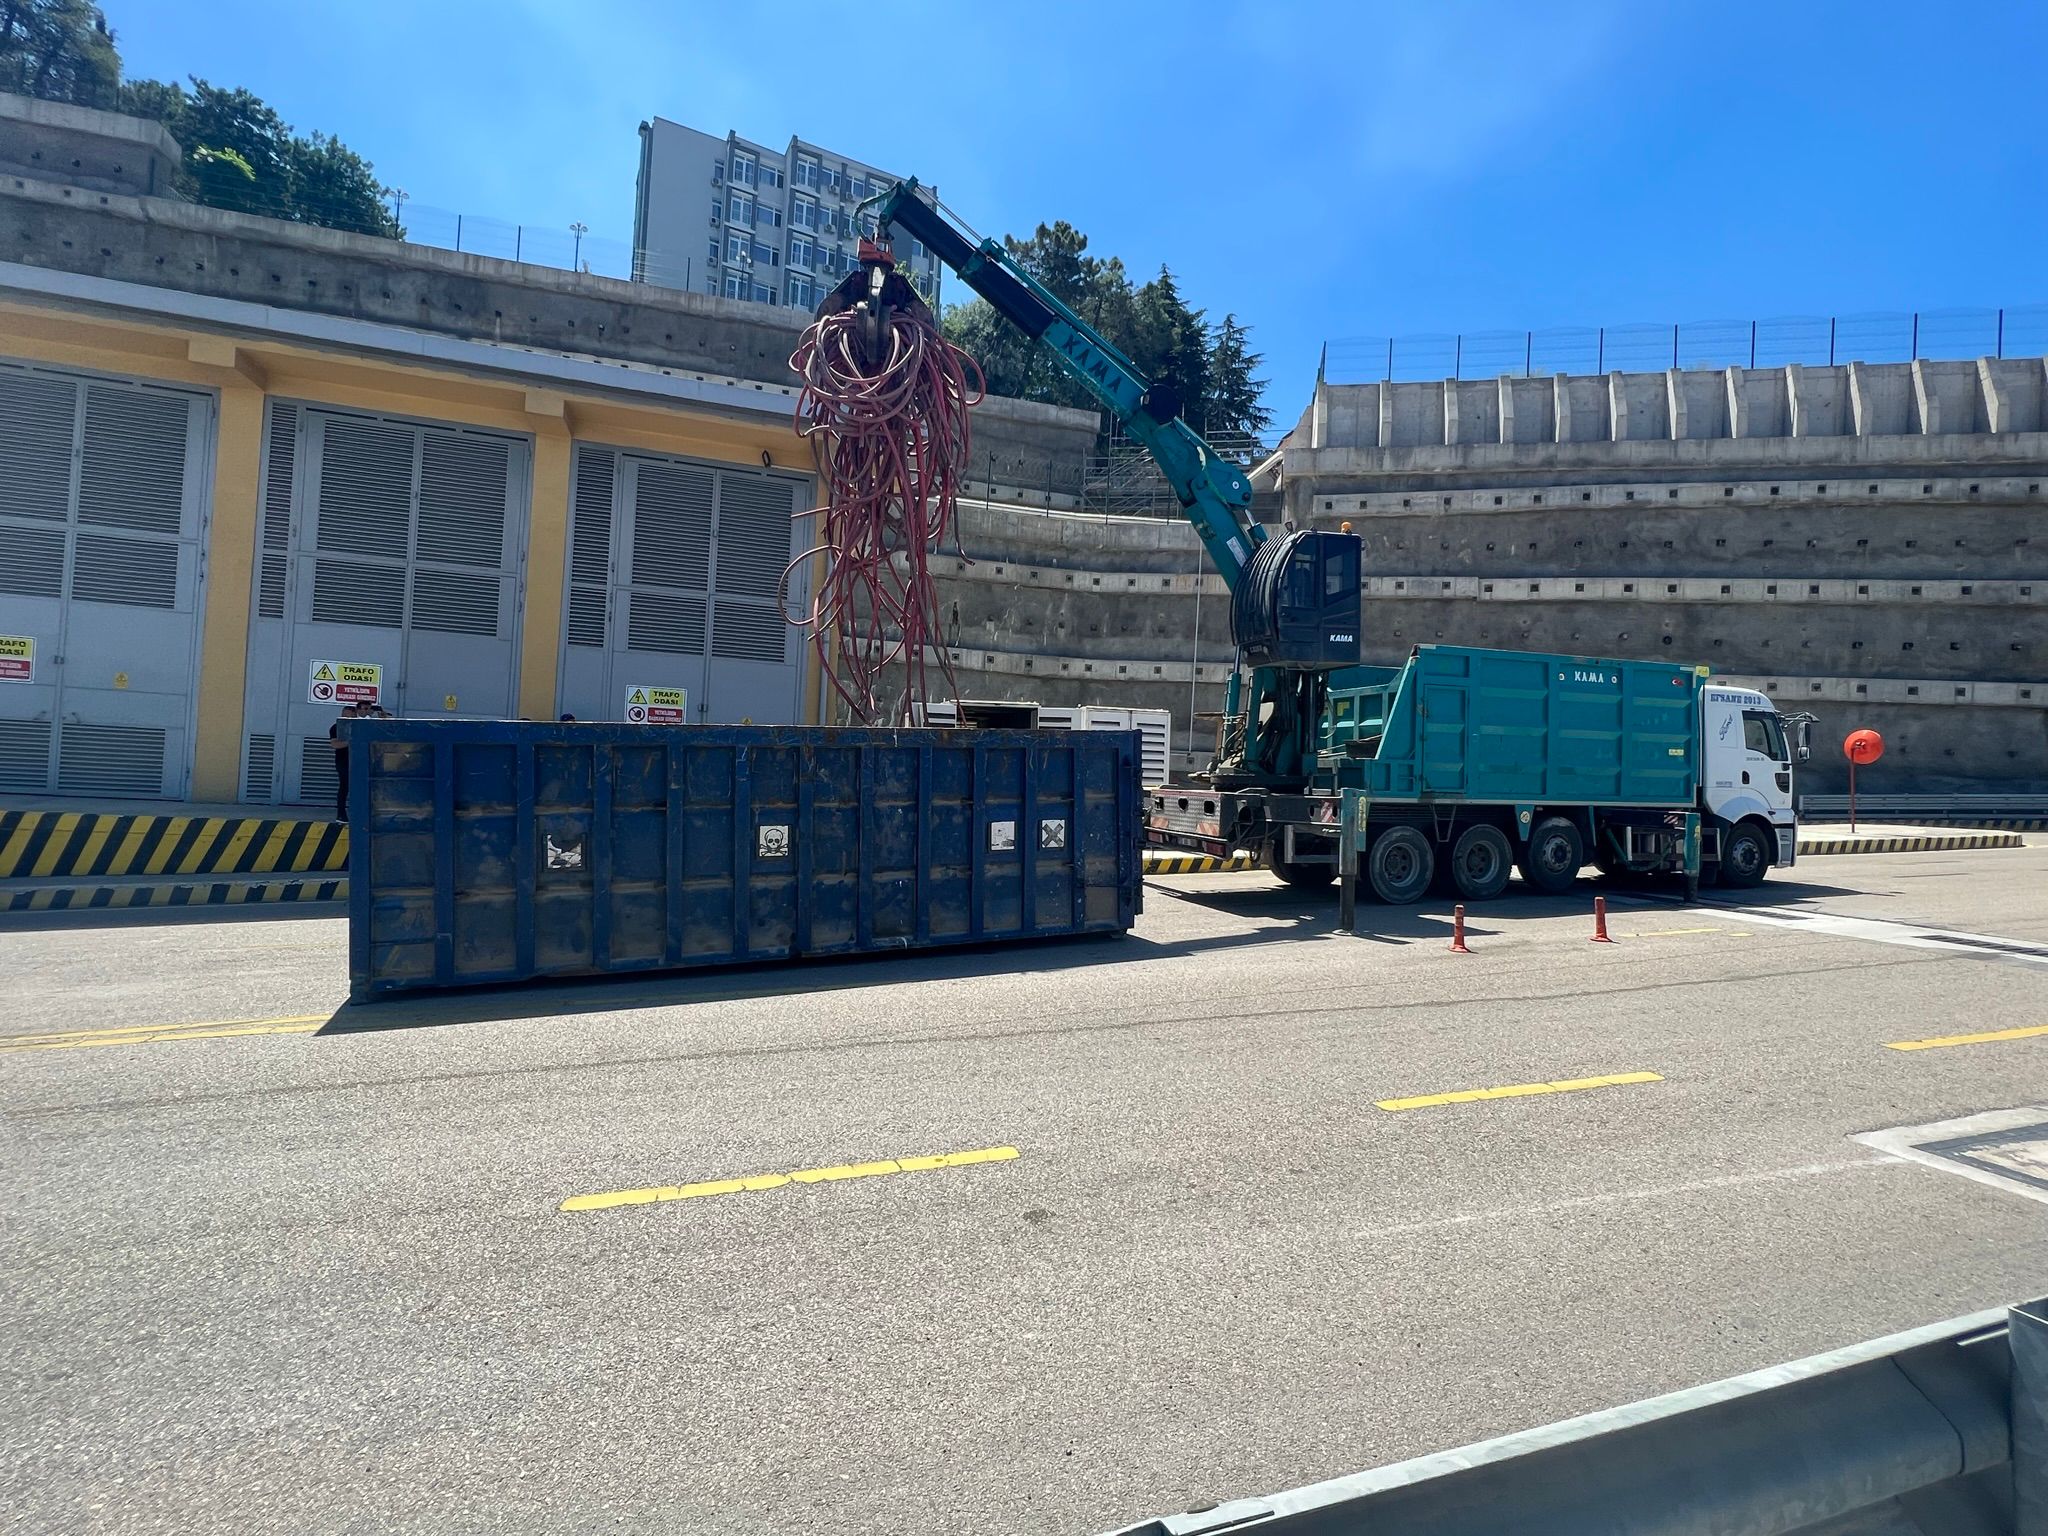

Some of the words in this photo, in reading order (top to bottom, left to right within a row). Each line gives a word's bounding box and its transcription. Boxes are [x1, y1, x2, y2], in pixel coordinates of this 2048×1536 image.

[1061, 333, 1122, 394] KAMA
[1329, 634, 1353, 643] KAMA
[343, 666, 375, 675] TRAFO
[1574, 670, 1604, 683] KAMA
[653, 690, 680, 698] TRAFO
